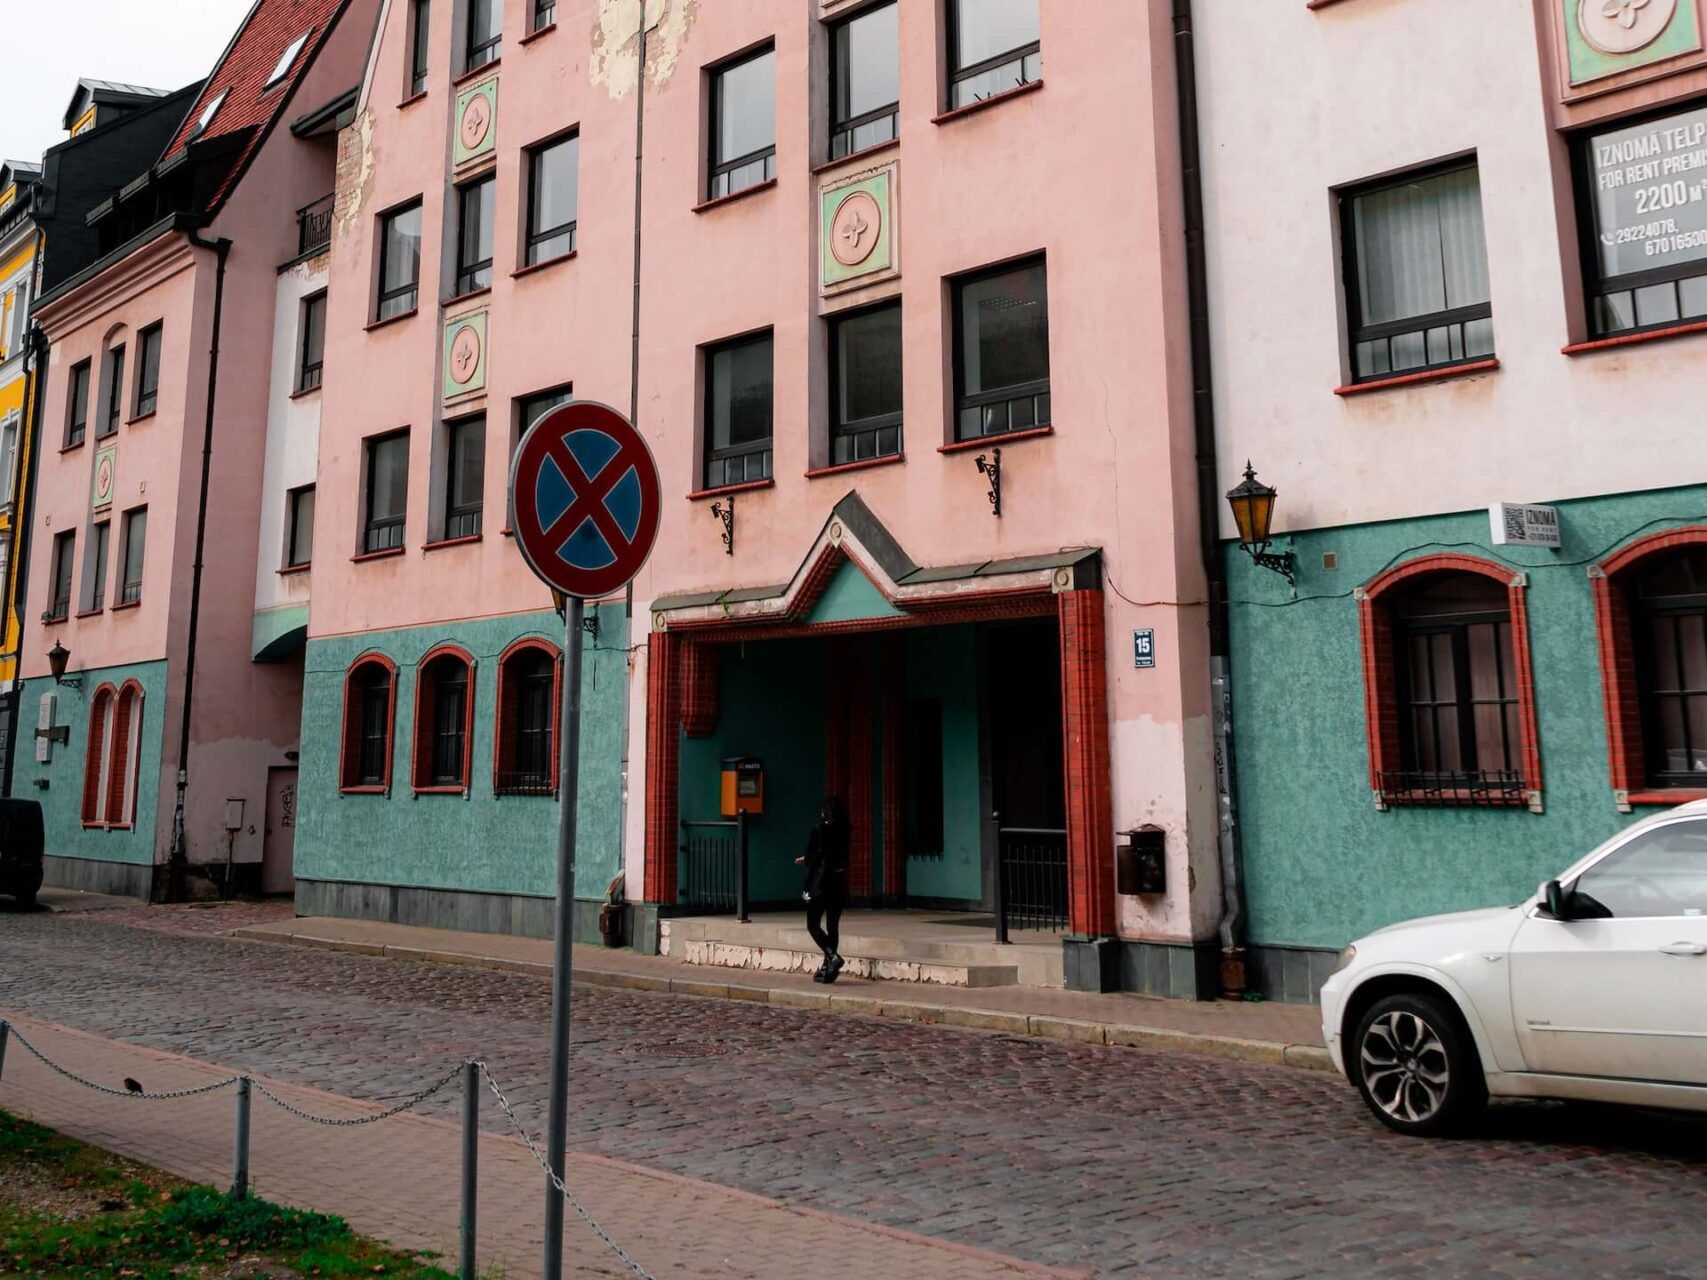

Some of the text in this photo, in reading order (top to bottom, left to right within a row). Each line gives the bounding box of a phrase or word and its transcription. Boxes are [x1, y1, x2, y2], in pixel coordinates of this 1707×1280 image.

[1596, 122, 1707, 168] IZNOMĀ TELP
[1600, 170, 1624, 190] FOR
[1626, 160, 1660, 184] RENT
[1635, 180, 1688, 214] 2200
[1136, 637, 1150, 653] 15
